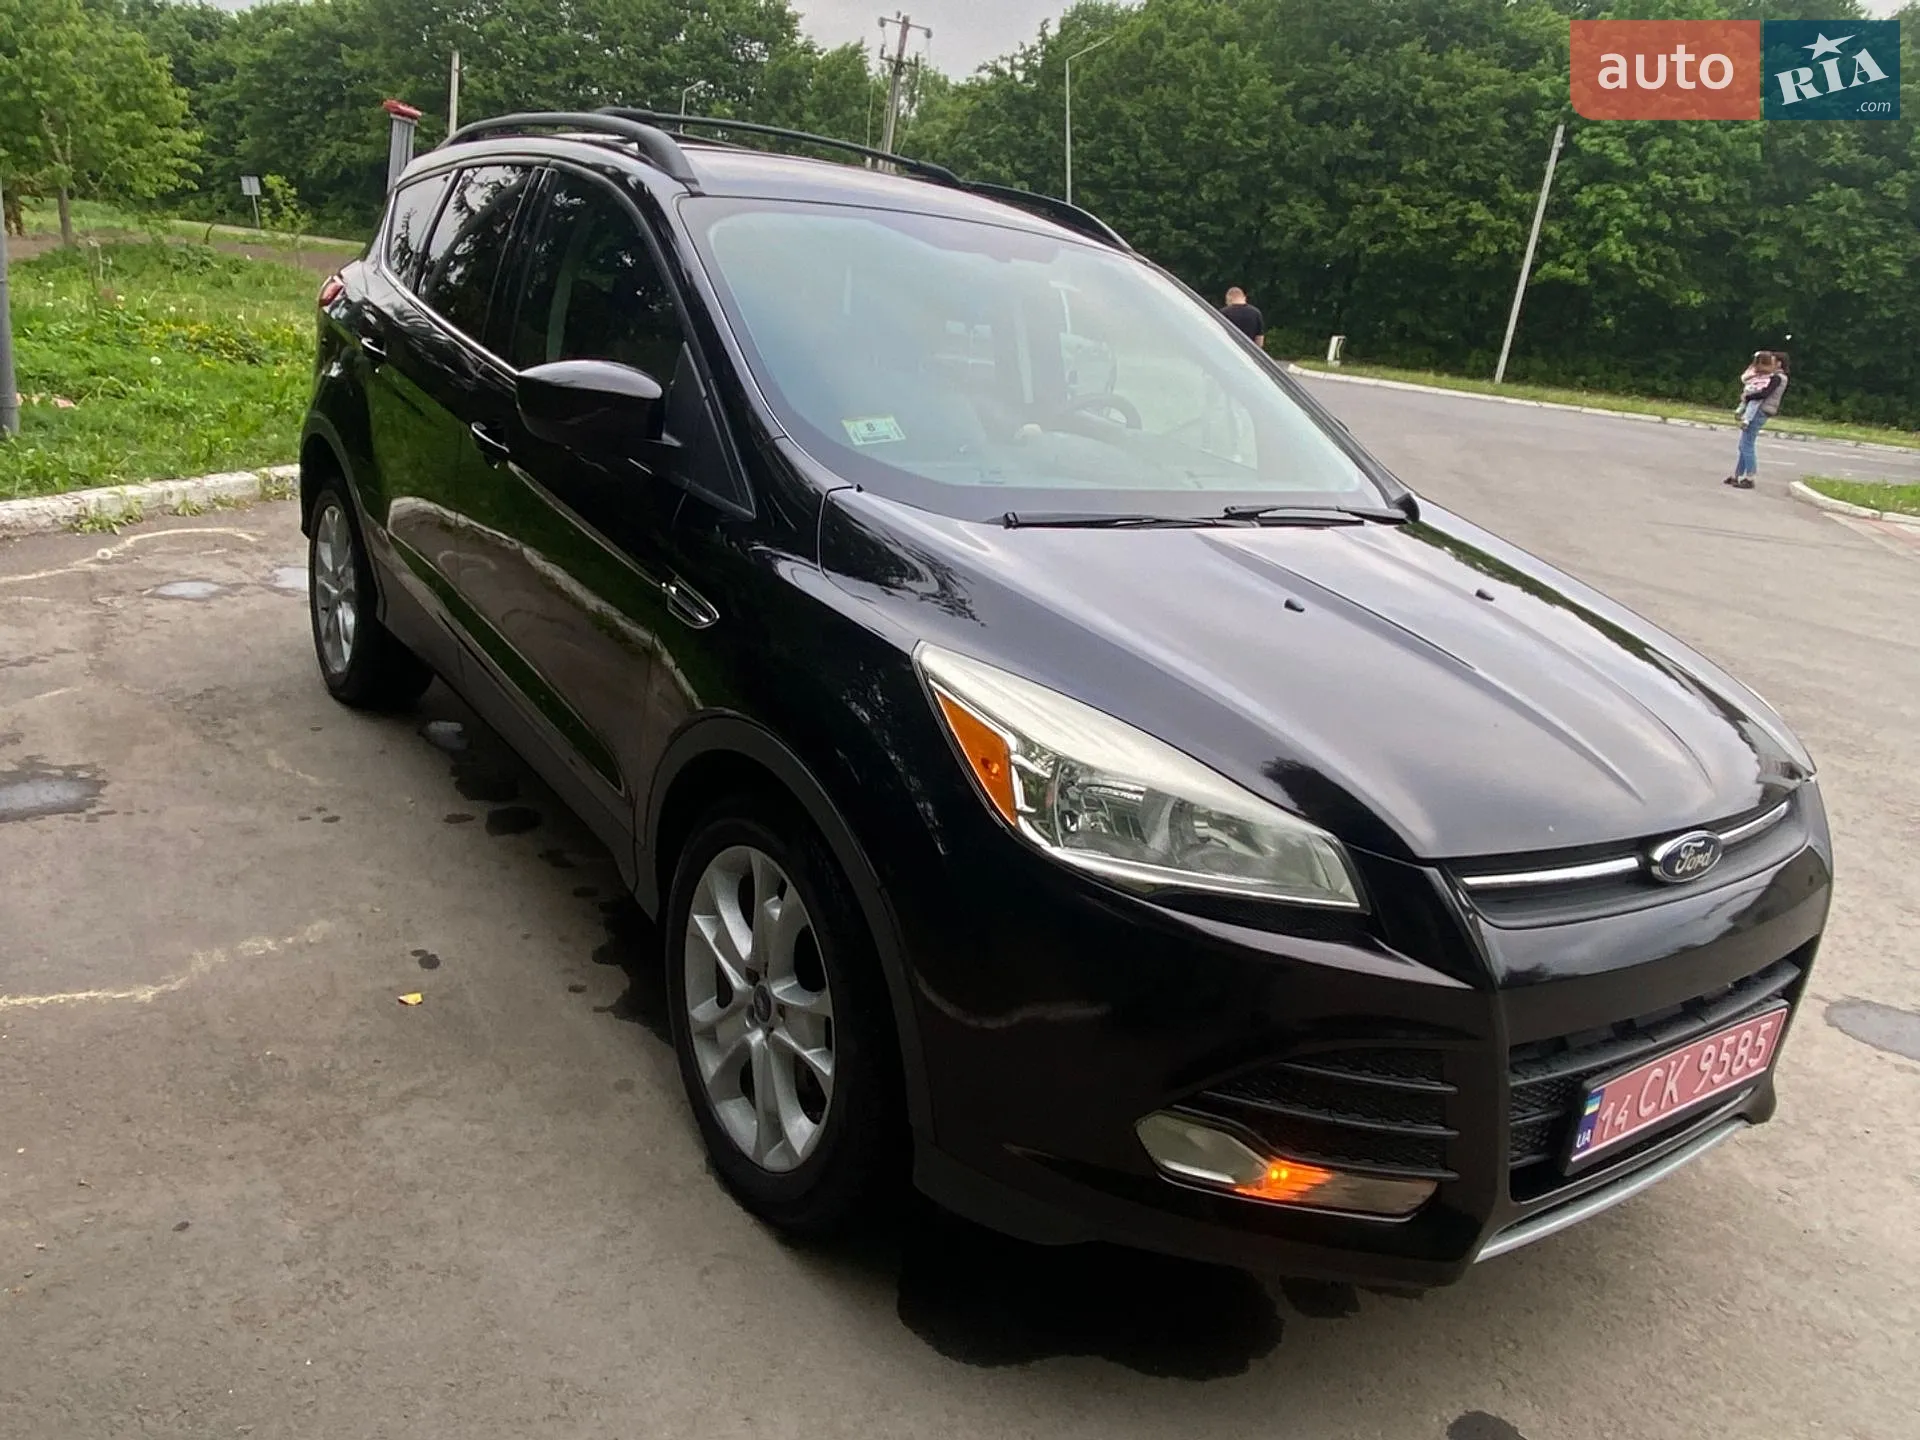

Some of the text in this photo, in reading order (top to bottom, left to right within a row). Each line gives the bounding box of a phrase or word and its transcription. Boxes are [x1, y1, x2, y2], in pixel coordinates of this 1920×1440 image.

[1675, 840, 1714, 874] Ford
[1601, 1021, 1773, 1139] 14 CK 9585
[1576, 1131, 1592, 1148] UA
